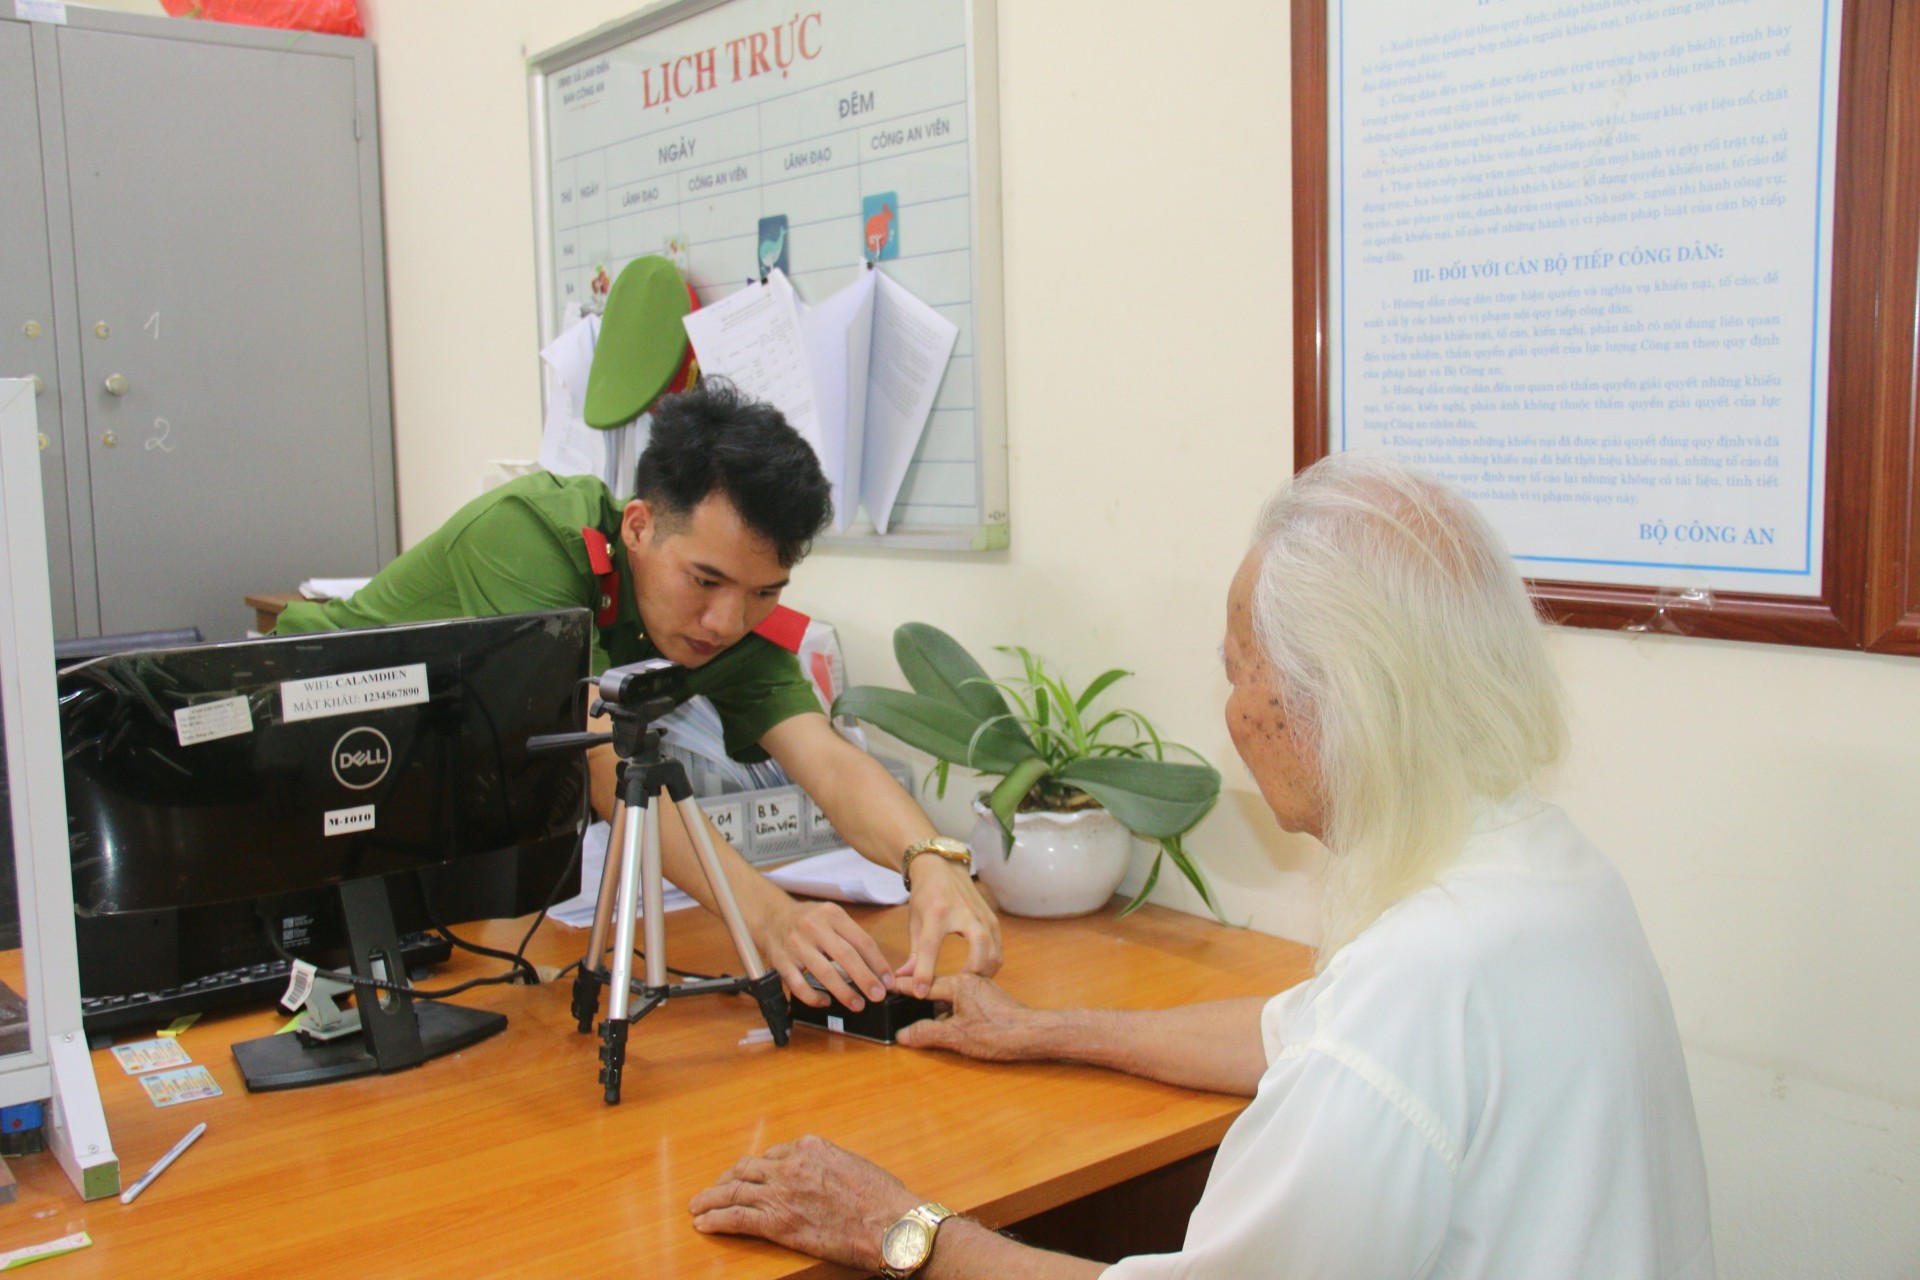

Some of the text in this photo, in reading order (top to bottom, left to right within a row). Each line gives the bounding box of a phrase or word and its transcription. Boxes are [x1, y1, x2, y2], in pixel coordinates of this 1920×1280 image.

[641, 12, 823, 113] LỊCH TRỰC
[838, 90, 875, 119] ĐÊM
[871, 118, 950, 151] CÔNG AN VIÊN
[658, 136, 697, 165] NGÀY
[715, 173, 728, 187] AN
[1505, 256, 1539, 276] CÁN
[1544, 253, 1569, 275] BỘ
[1573, 249, 1614, 270] TIẾP
[1619, 246, 1672, 267] CÔNG
[1677, 240, 1725, 262] DÂN:
[143, 311, 161, 340] 1
[145, 417, 176, 452] 2
[1639, 518, 1775, 545] BỘ CÔNG AN
[335, 669, 407, 688] CALAMDIEN
[363, 686, 420, 703] 1234567890
[339, 748, 386, 770] DELL
[328, 812, 372, 828] M-1010
